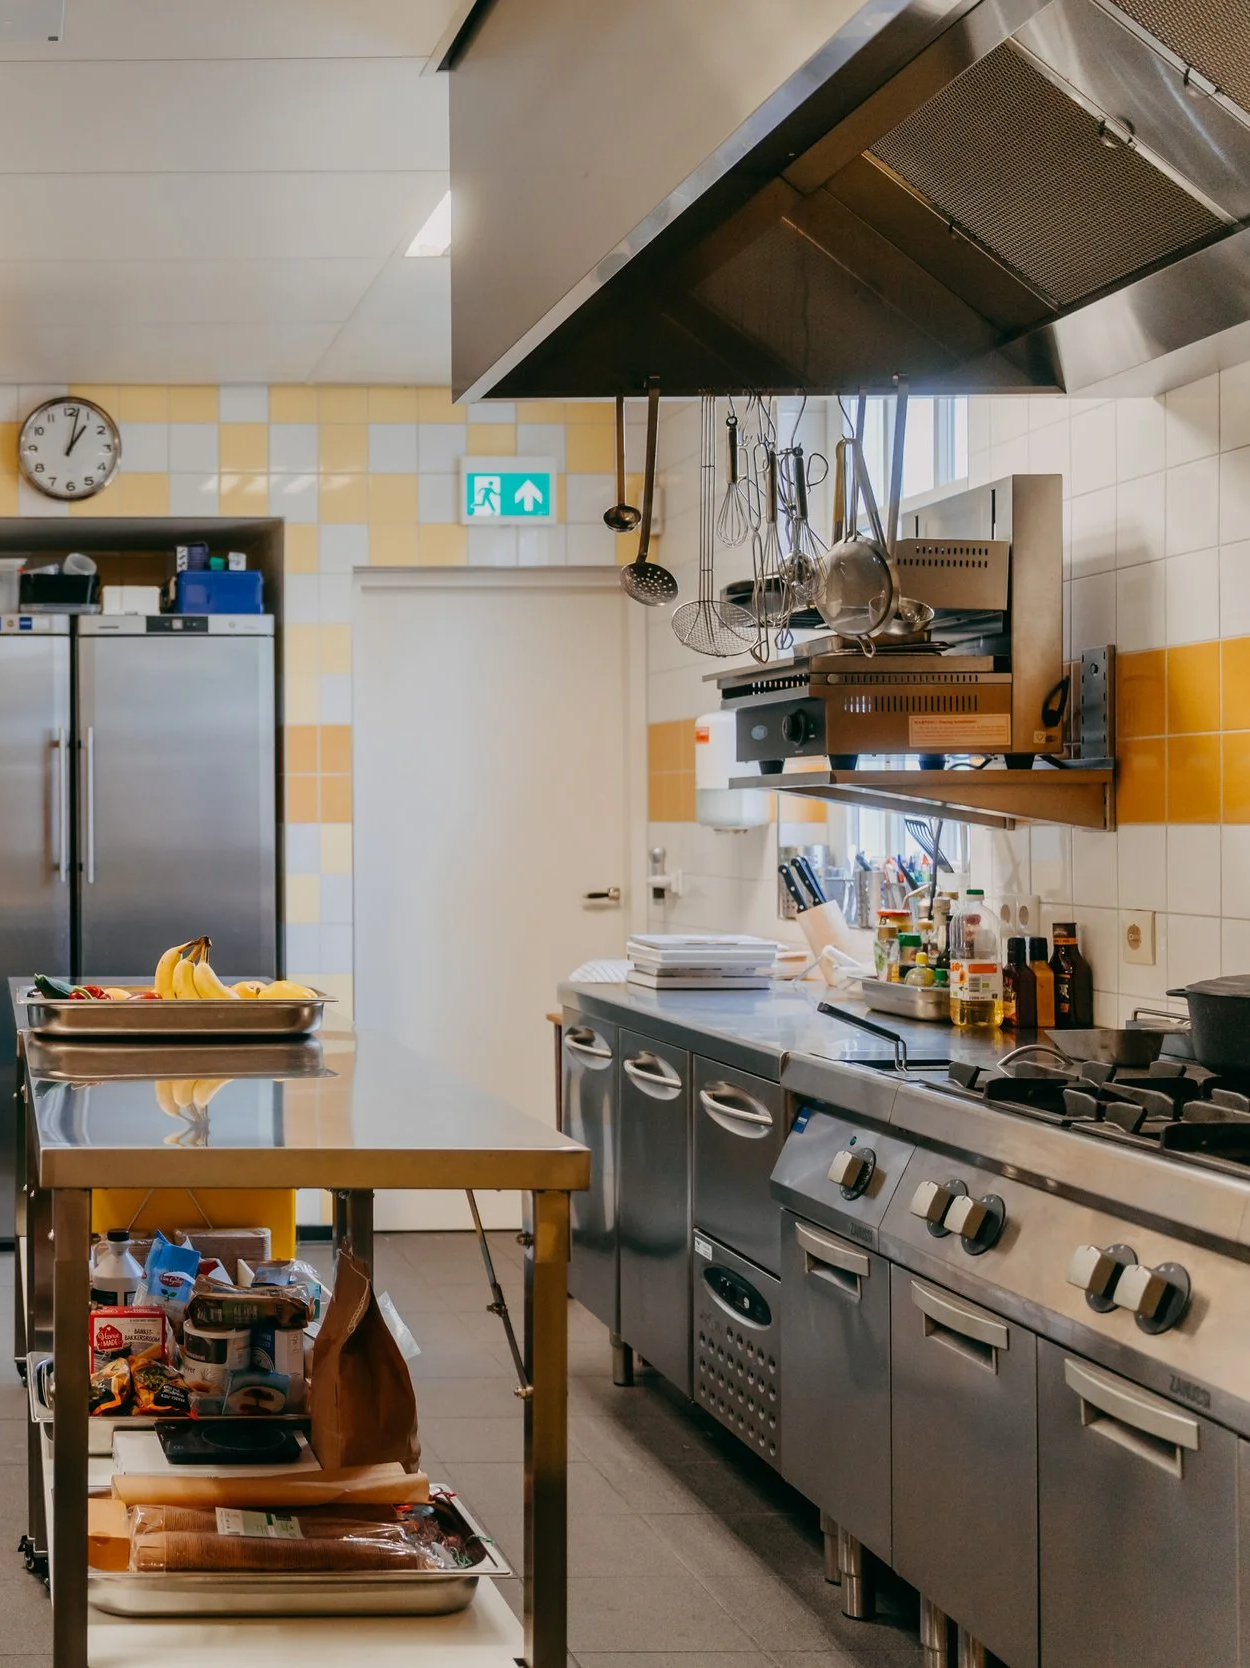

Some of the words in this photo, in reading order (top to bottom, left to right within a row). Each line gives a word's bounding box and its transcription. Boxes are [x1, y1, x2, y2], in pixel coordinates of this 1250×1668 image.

[47, 413, 55, 422] 11
[63, 407, 77, 418] 12
[34, 426, 45, 436] 10
[96, 425, 106, 435] 2
[28, 444, 38, 453] 9
[102, 444, 112, 453] 3
[34, 463, 45, 473] 8
[96, 462, 106, 471] 4
[48, 476, 57, 487] 7
[84, 476, 94, 486] 5
[65, 481, 76, 492] 6
[850, 1221, 873, 1243] ZANUSSI
[124, 1334, 160, 1343] BAKKERSROOM
[1168, 1373, 1211, 1410] ZANUSSI
